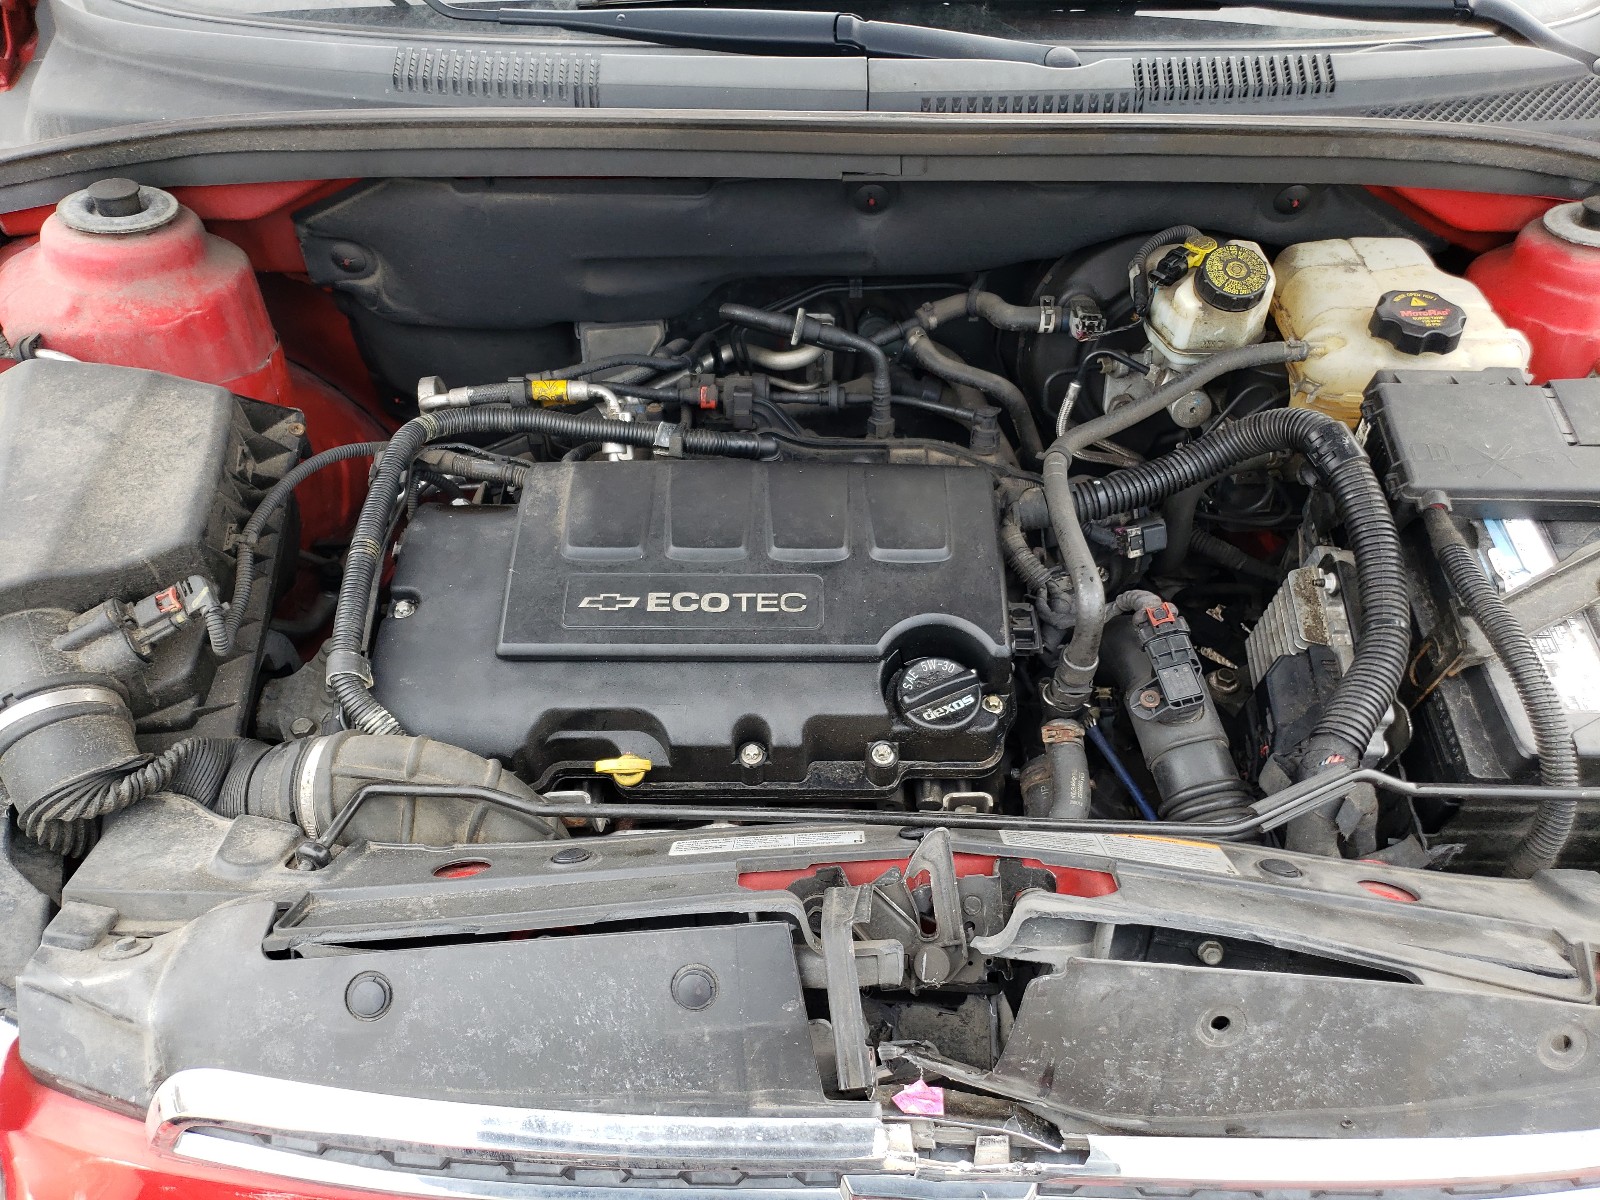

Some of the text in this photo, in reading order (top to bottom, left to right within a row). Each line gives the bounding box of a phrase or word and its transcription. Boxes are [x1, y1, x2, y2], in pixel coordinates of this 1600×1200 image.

[647, 592, 807, 613] ECOTEC
[902, 659, 955, 690] SAE 5W-30
[922, 694, 975, 721] dexos
